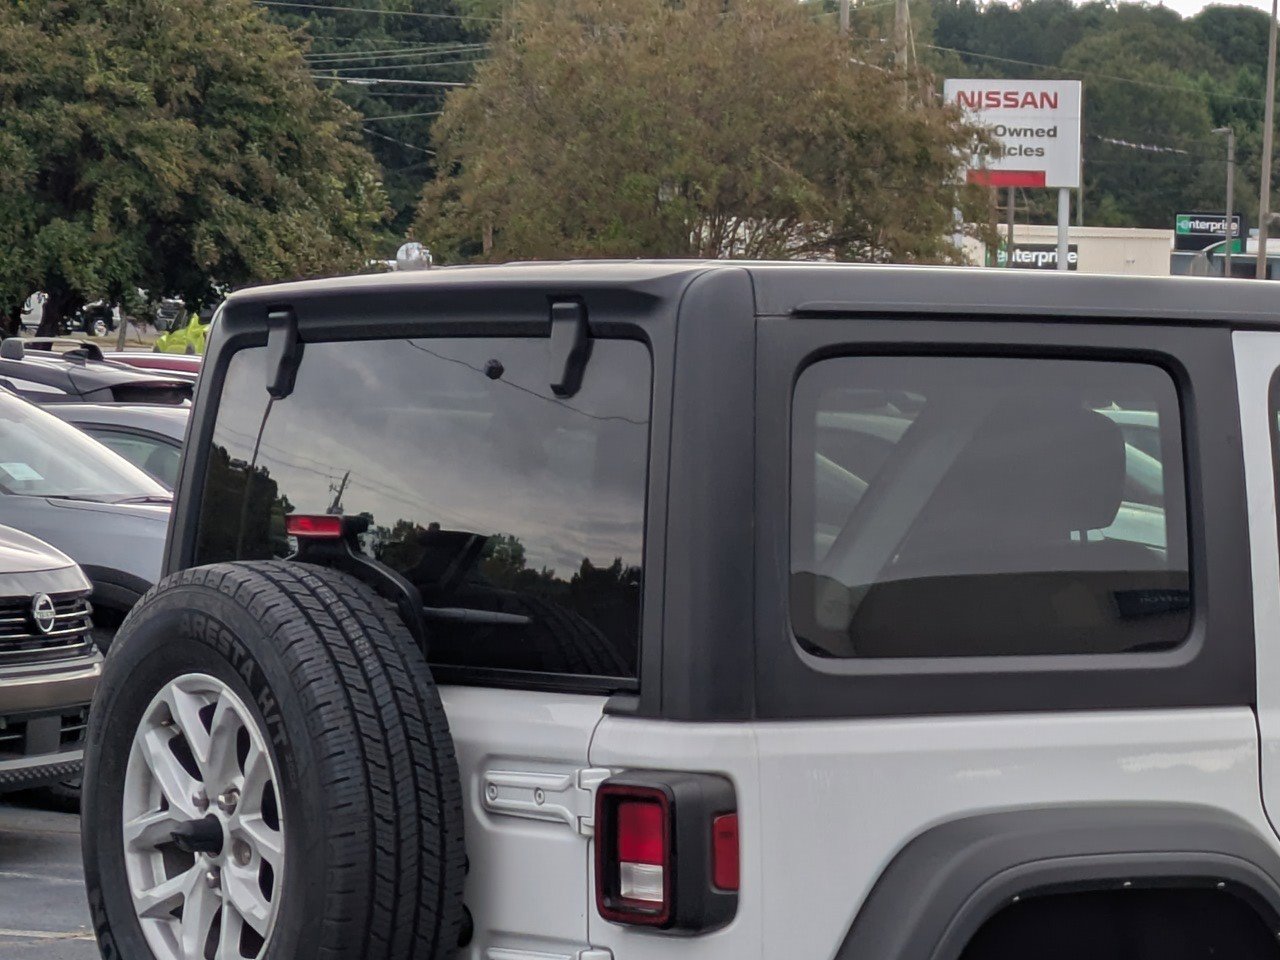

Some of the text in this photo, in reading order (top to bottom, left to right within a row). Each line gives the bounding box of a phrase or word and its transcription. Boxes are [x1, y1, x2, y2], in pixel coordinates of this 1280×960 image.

[957, 90, 1059, 110] NISSAN
[1181, 219, 1238, 233] enterprie
[996, 248, 1079, 267] eterprie
